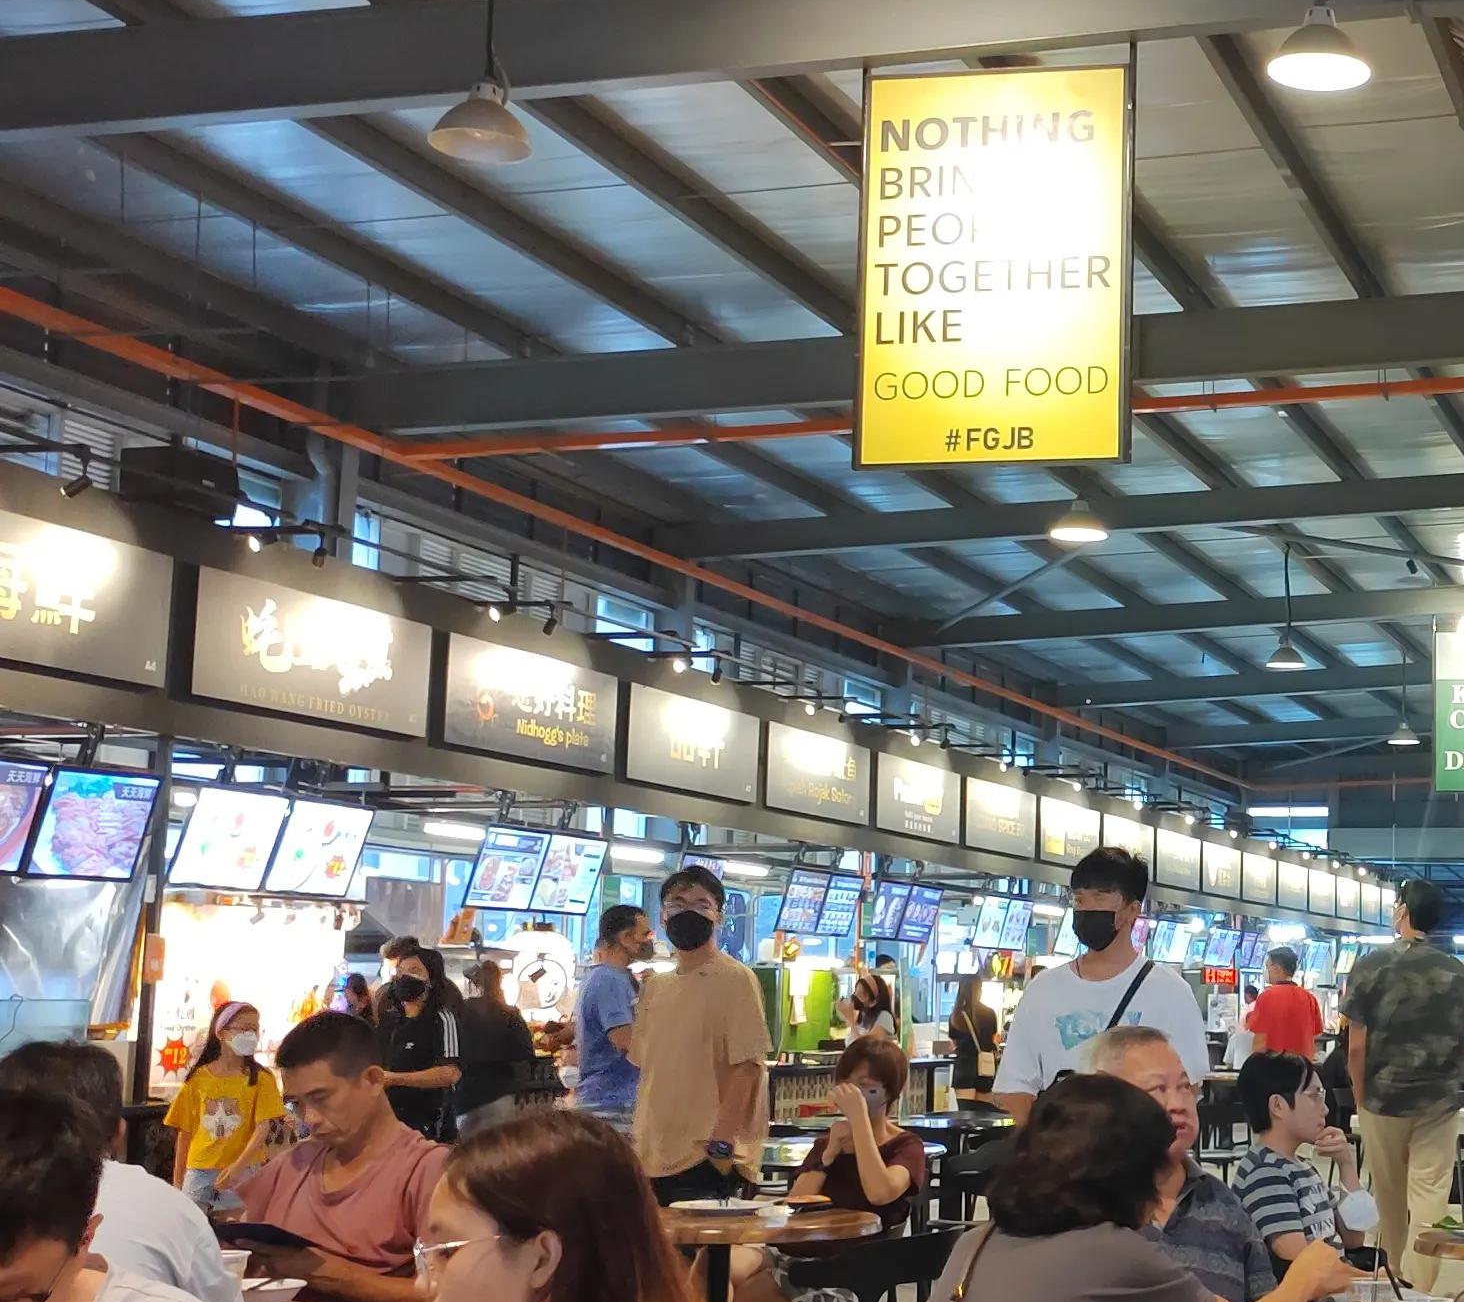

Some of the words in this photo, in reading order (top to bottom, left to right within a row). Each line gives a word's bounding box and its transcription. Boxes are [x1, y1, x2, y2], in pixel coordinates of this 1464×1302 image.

[880, 110, 1095, 153] NOTHING
[875, 255, 1112, 297] TOGETHER
[875, 309, 964, 346] LIKE
[874, 370, 985, 401] GOOD
[1005, 366, 1109, 397] FOOD
[945, 426, 1035, 452] #FGJB
[308, 696, 345, 715] FRIED
